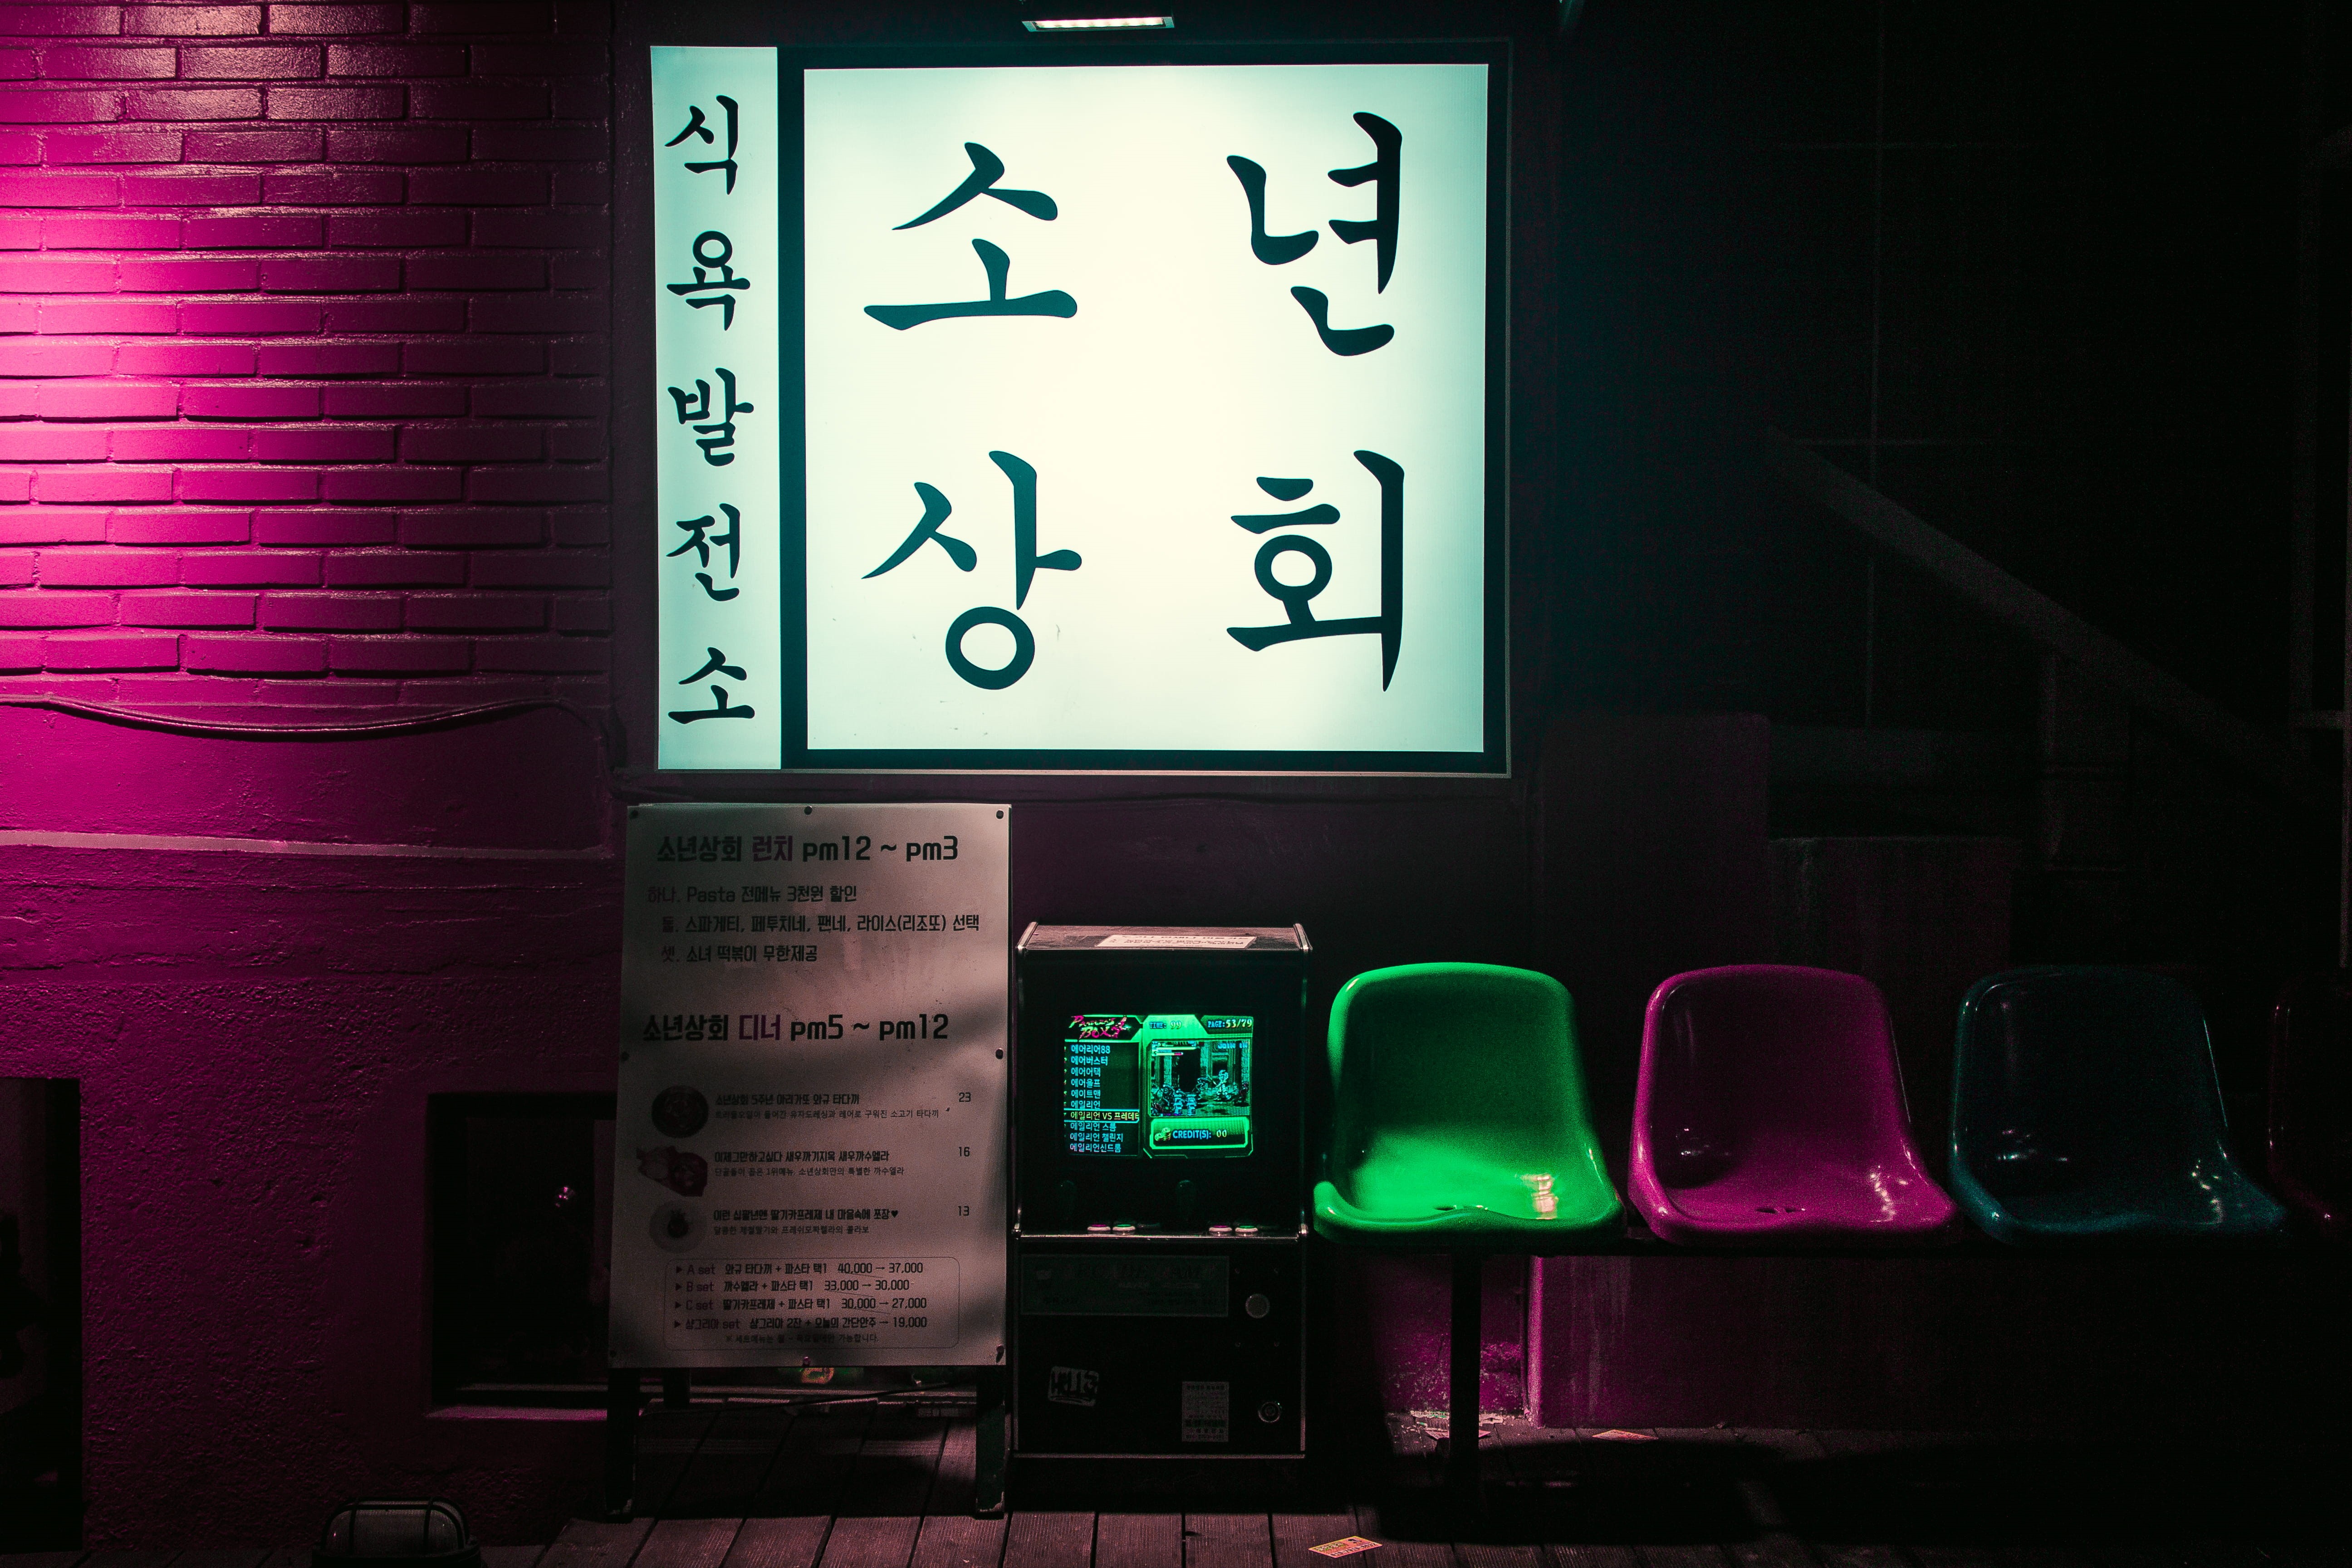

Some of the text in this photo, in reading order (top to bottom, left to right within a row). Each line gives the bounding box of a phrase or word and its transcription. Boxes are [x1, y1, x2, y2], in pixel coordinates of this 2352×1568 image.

[665, 95, 755, 724] 식욕발전소
[657, 836, 741, 862] 소년상회
[752, 836, 793, 862] 런치
[803, 835, 871, 862] pm12
[906, 835, 958, 862] pm3
[647, 885, 857, 903] 하나. Pasta 전메뉴 3천원 할인
[663, 916, 679, 932] 둘.
[685, 916, 745, 933] 스파게티,
[818, 915, 851, 932] 팬네,
[857, 915, 946, 932] 라이스(리조또)
[953, 914, 979, 931] 선택
[661, 945, 817, 962] 셋. 소녀 떡볶이 무한제공
[643, 1014, 728, 1041] 소년상회
[739, 1014, 780, 1040] 디너
[790, 1014, 843, 1040] pm5
[879, 1014, 948, 1040] pm12
[1170, 1021, 1181, 1029] 99
[1225, 1019, 1252, 1028] 53/79
[1071, 1045, 1110, 1054] 에어리어88
[1071, 1056, 1108, 1066] 에어버스터
[1071, 1067, 1101, 1077] 에어어택
[1071, 1078, 1100, 1088] 에어울프
[959, 1093, 971, 1102] 23
[1071, 1090, 1100, 1098] 에이트맨
[715, 1094, 859, 1105] 소년상회 5주년 아리가또 와규 타다끼
[1071, 1101, 1100, 1109] 에일리언
[1070, 1112, 1100, 1120] 에일리언
[1070, 1122, 1100, 1131] 에일리언
[1070, 1133, 1123, 1142] 에일리언 챌린지
[1173, 1129, 1227, 1139] CREDIT(S): 00
[959, 1147, 970, 1157] 16
[957, 1206, 970, 1216] 13
[687, 1265, 695, 1274] A
[699, 1265, 715, 1274] set
[725, 1264, 741, 1274] 와규
[745, 1264, 772, 1274] 타다끼
[785, 1264, 810, 1274] 파스타
[838, 1263, 872, 1274] 40,000
[889, 1263, 923, 1273] 37,000
[687, 1282, 693, 1291] B
[697, 1282, 714, 1291] set
[725, 1281, 758, 1291] 까수엘라
[772, 1281, 796, 1291] 파스타
[824, 1280, 858, 1291] 33,000
[875, 1280, 909, 1290] 30,000
[686, 1300, 692, 1310] C
[696, 1300, 713, 1310] set
[789, 1299, 813, 1309] 파스타
[842, 1298, 876, 1309] 30,000
[892, 1298, 926, 1308] 27,000
[723, 1318, 740, 1328] set
[787, 1318, 802, 1328] 2잔
[843, 1317, 876, 1328] 간단안주
[893, 1317, 926, 1327] 19,000
